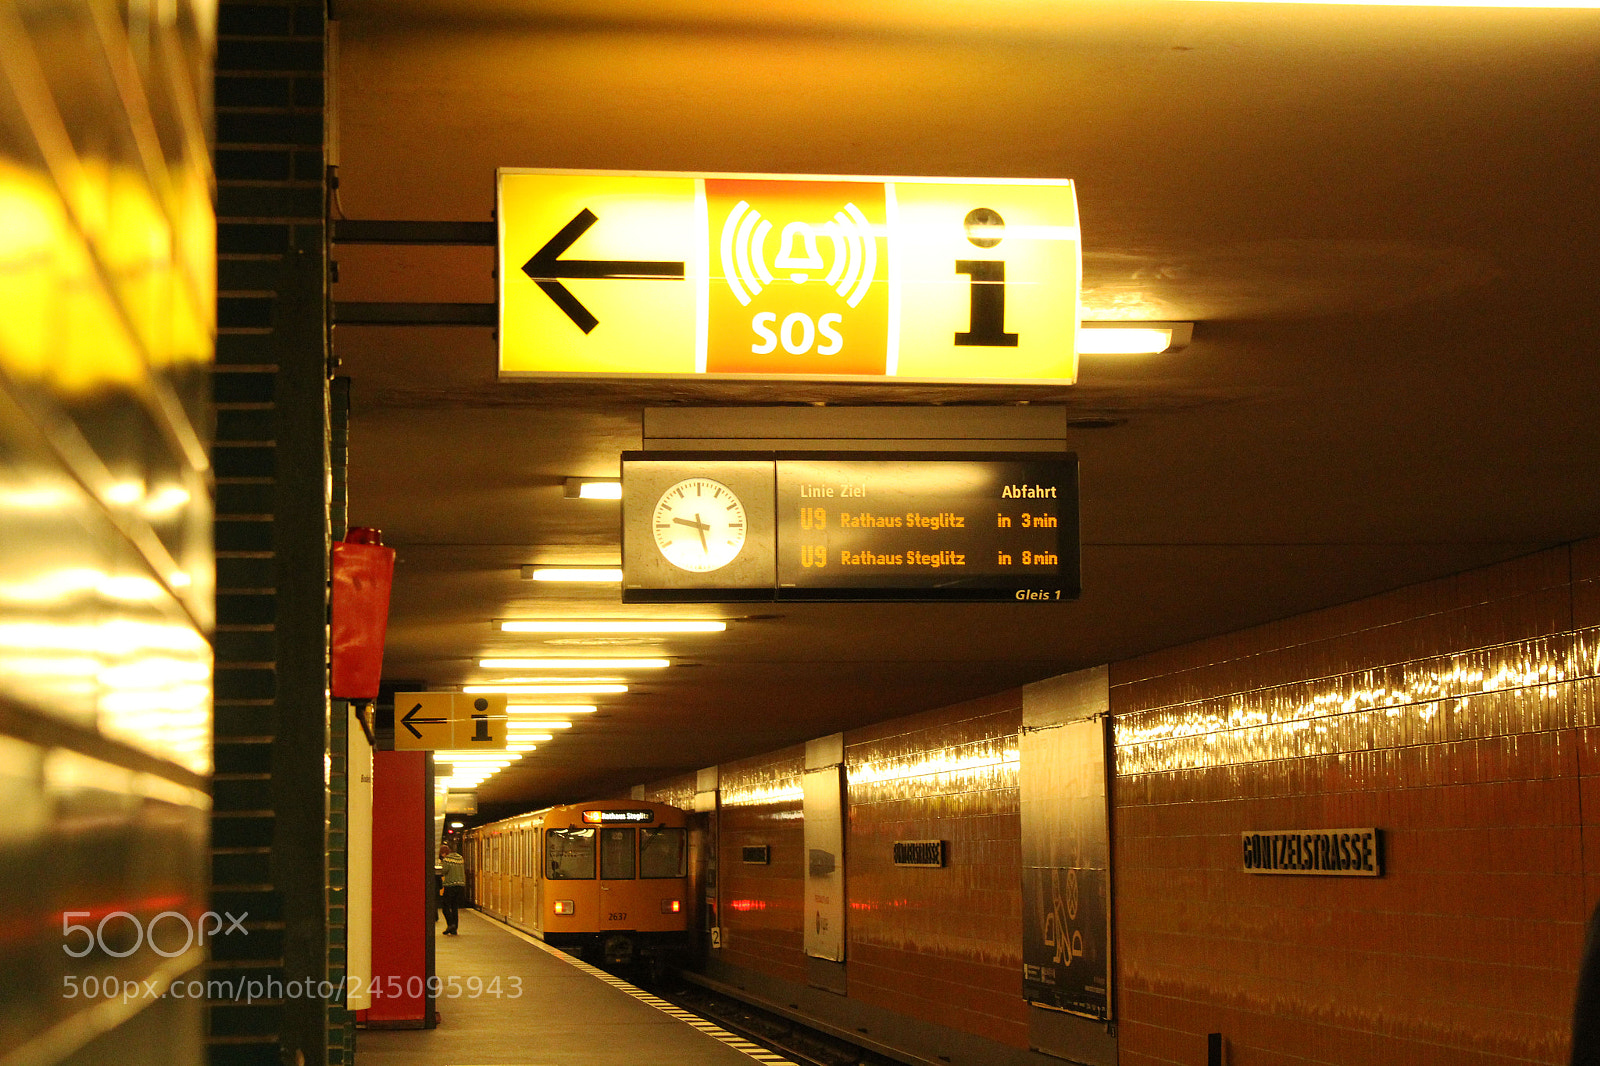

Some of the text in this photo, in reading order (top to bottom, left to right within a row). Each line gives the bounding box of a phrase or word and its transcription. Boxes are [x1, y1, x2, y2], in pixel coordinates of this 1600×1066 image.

[751, 311, 844, 356] SOS
[800, 483, 867, 498] Linie Ziel
[1001, 484, 1058, 499] Abfahrt
[800, 507, 827, 531] U9
[840, 512, 903, 528] Rathaus
[906, 512, 966, 531] Steglitz
[997, 512, 1012, 528] in
[800, 545, 828, 568] U9
[841, 550, 903, 566] Rathaus
[906, 550, 967, 568] Steglitz
[998, 550, 1013, 566] in
[1015, 589, 1062, 601] Gleis 1
[608, 912, 628, 921] 2637
